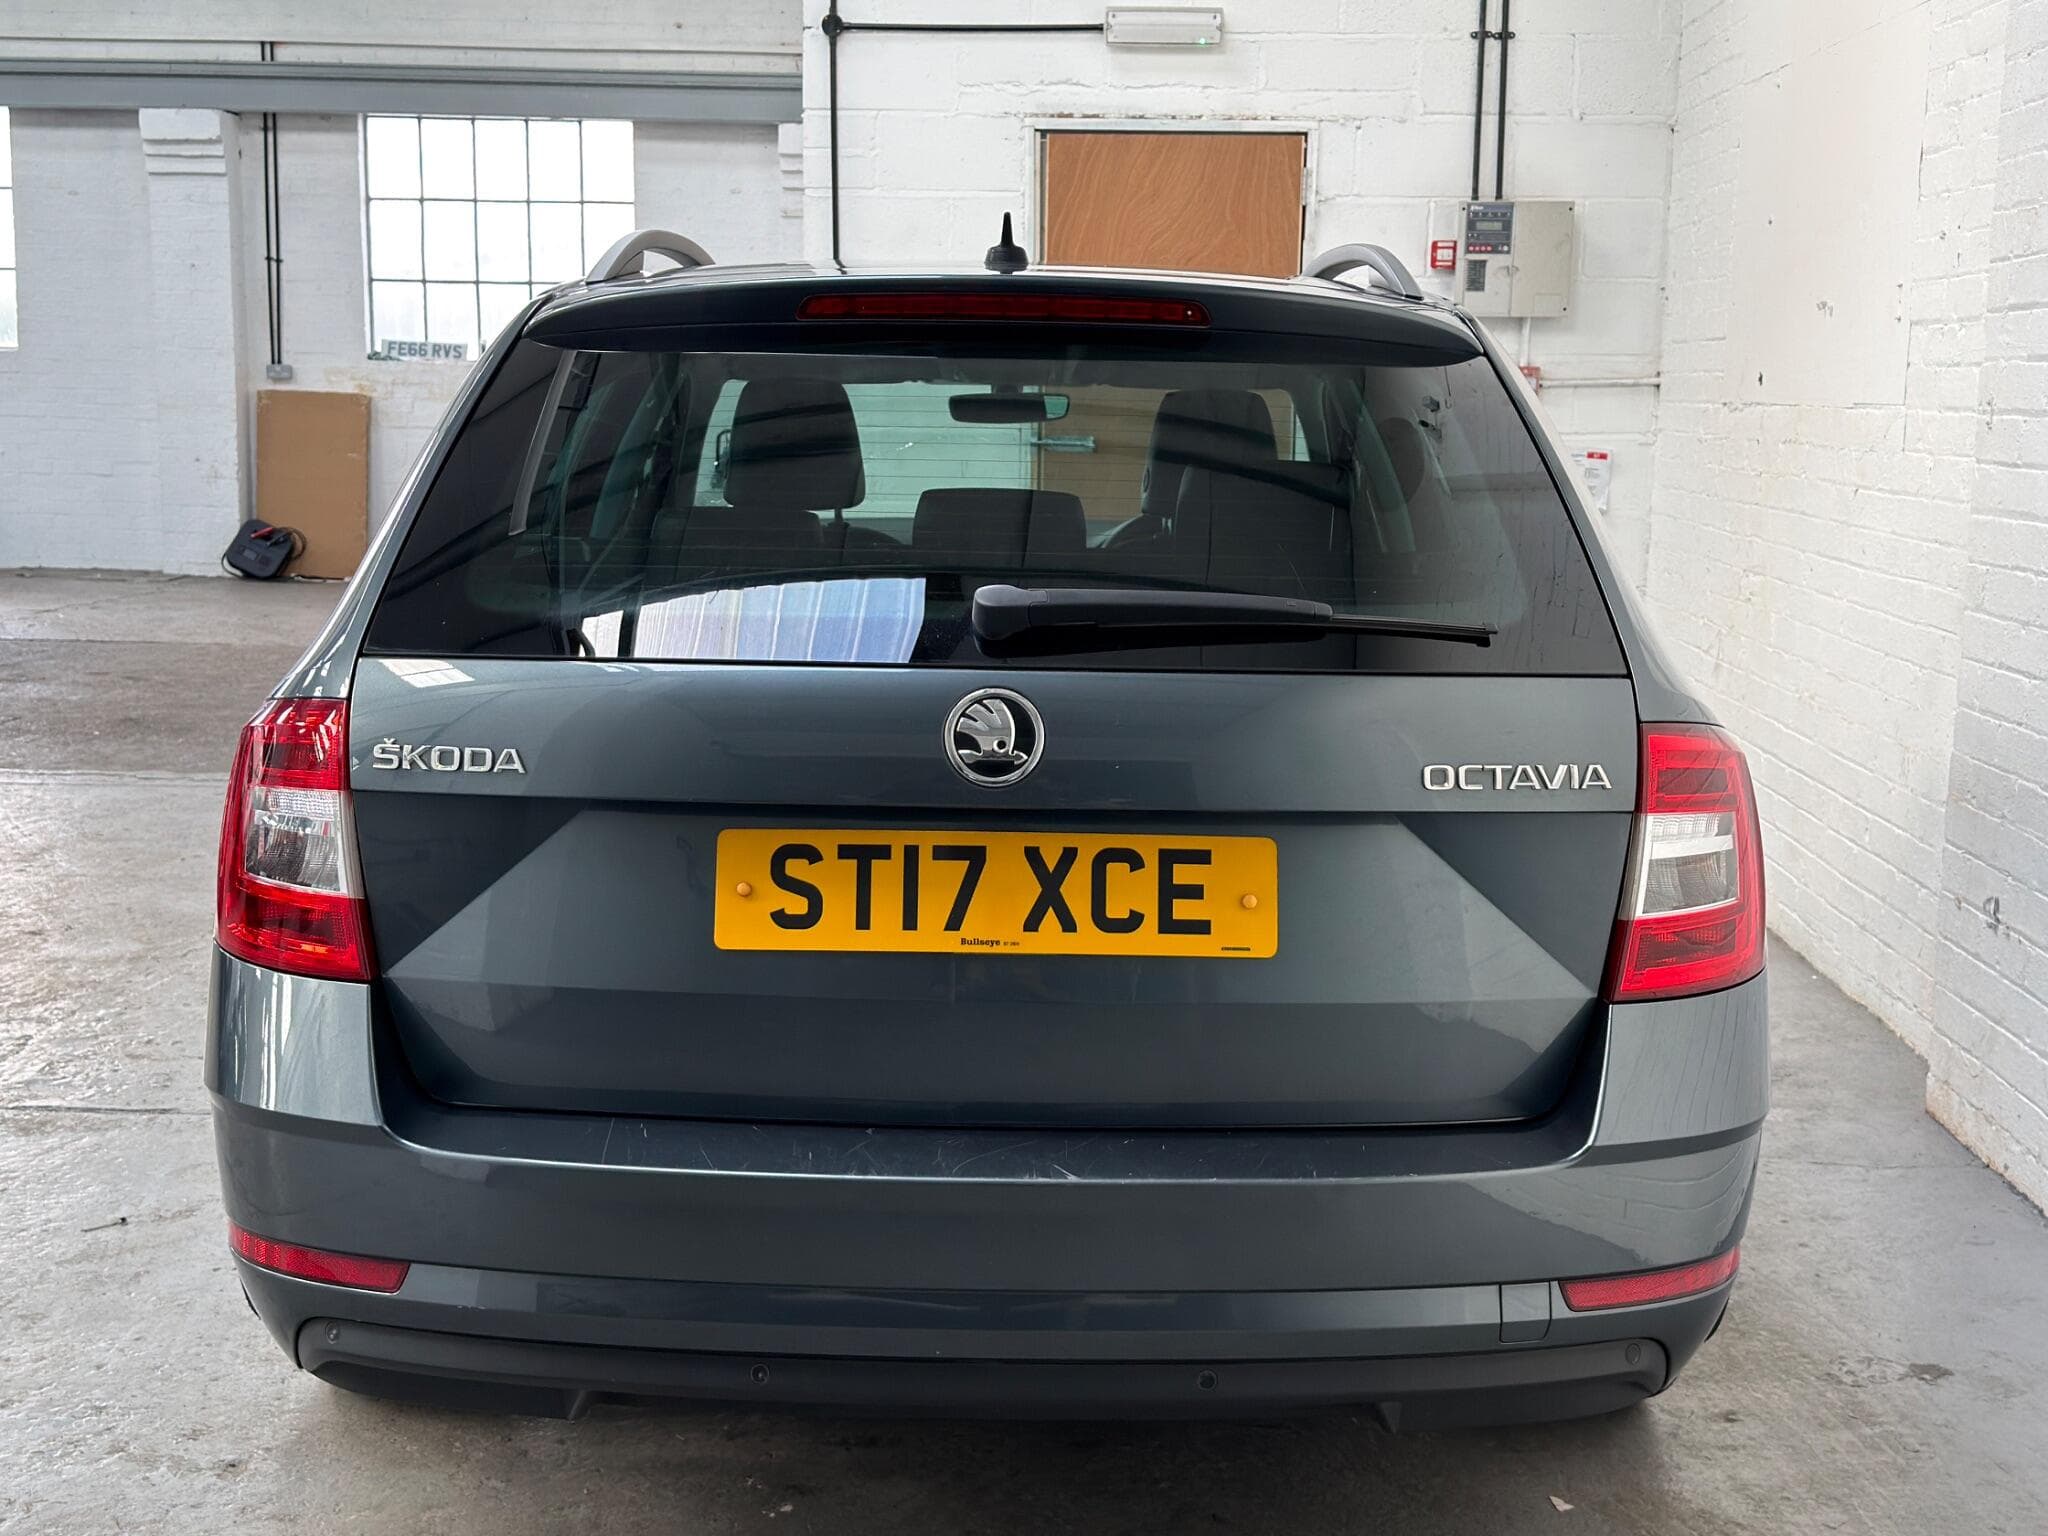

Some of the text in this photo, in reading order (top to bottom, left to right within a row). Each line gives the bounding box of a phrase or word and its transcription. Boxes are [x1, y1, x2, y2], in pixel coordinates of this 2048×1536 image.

[387, 341, 463, 359] FE66 RVS
[372, 737, 526, 774] ŠKODA
[1423, 763, 1612, 790] OCTAVIA
[769, 843, 1212, 935] ST17 XCE
[960, 937, 1001, 947] Bullseye
